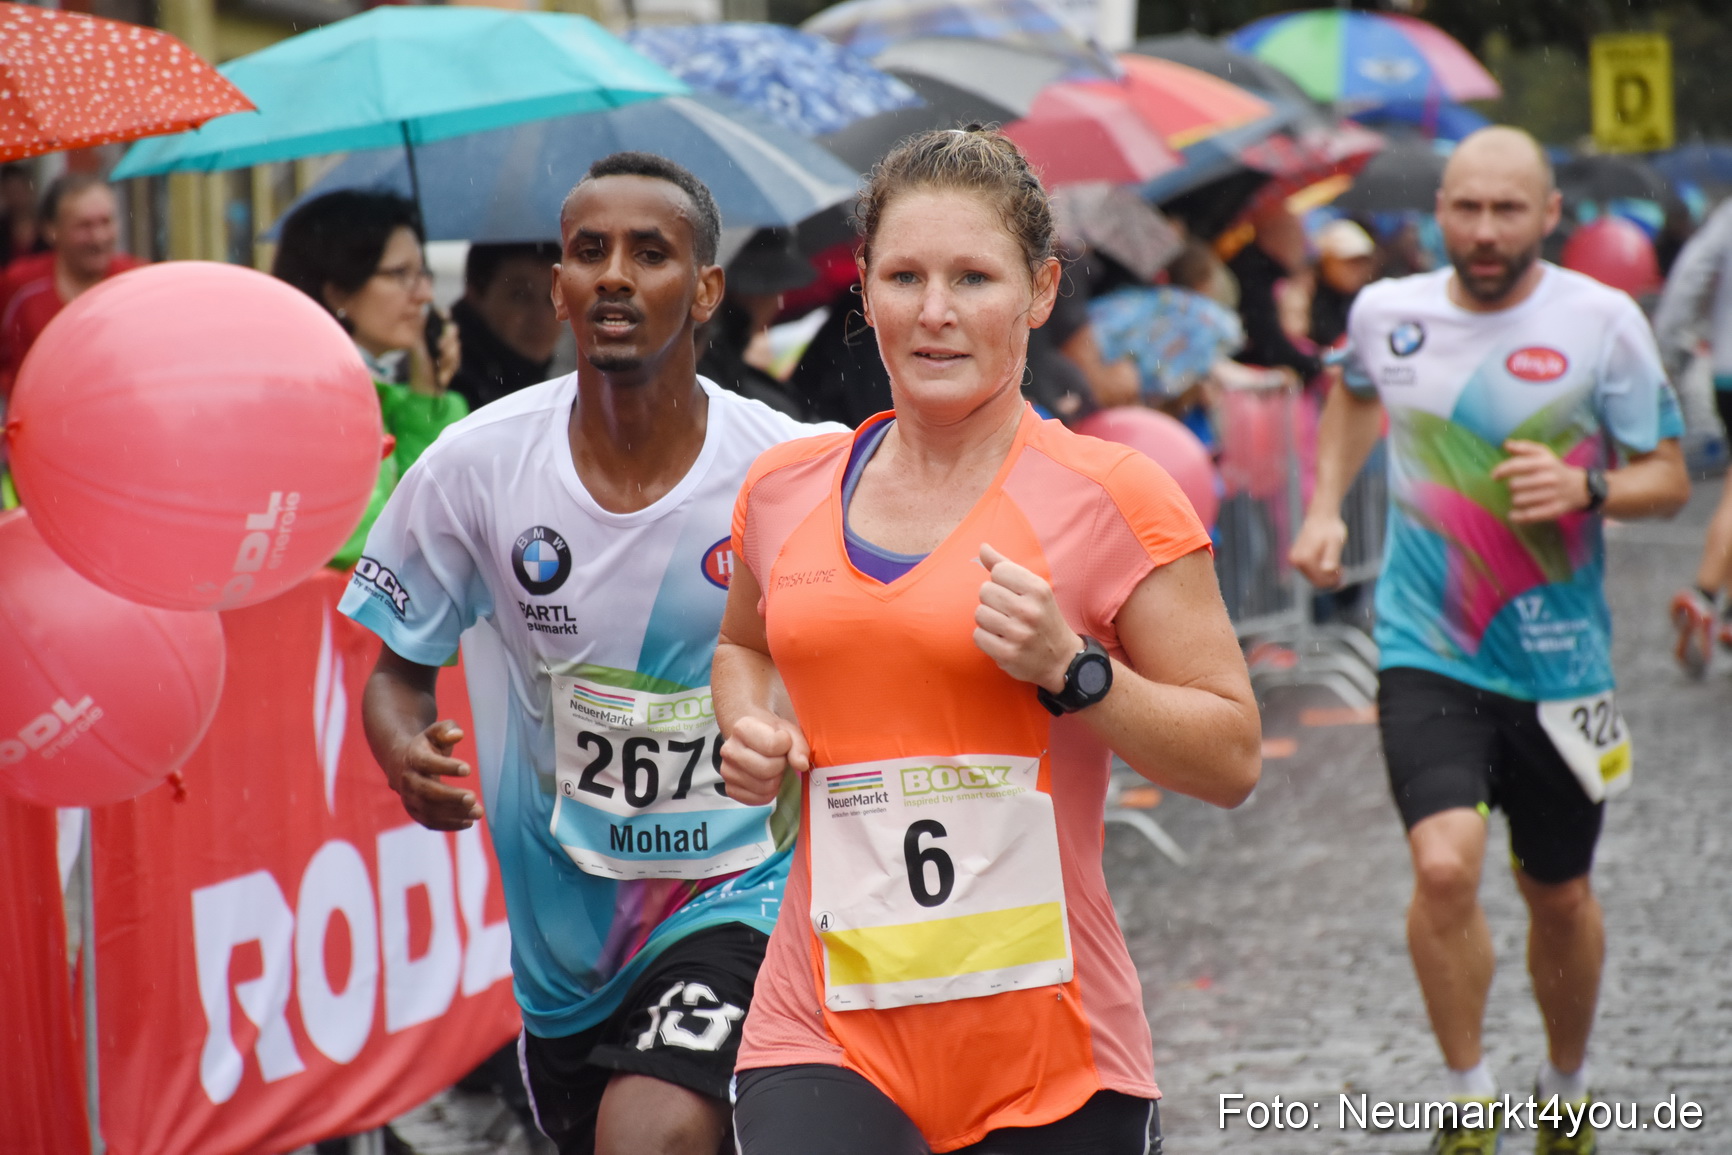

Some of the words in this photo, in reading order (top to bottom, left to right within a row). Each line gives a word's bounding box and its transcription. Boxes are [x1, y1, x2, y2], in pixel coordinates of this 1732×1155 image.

[1614, 72, 1652, 124] D
[208, 491, 283, 606] ODL
[516, 527, 566, 551] BMW
[806, 569, 836, 585] LINE
[570, 699, 635, 727] NeuerMarkt
[684, 722, 694, 732] by
[900, 765, 1013, 797] BOCK
[827, 791, 889, 810] NeuerMarkt
[904, 796, 940, 808] inspired
[942, 794, 954, 804] by
[956, 791, 983, 801] smart
[986, 786, 1027, 799] concepts
[610, 822, 708, 854] Mohad
[903, 819, 955, 908] 6
